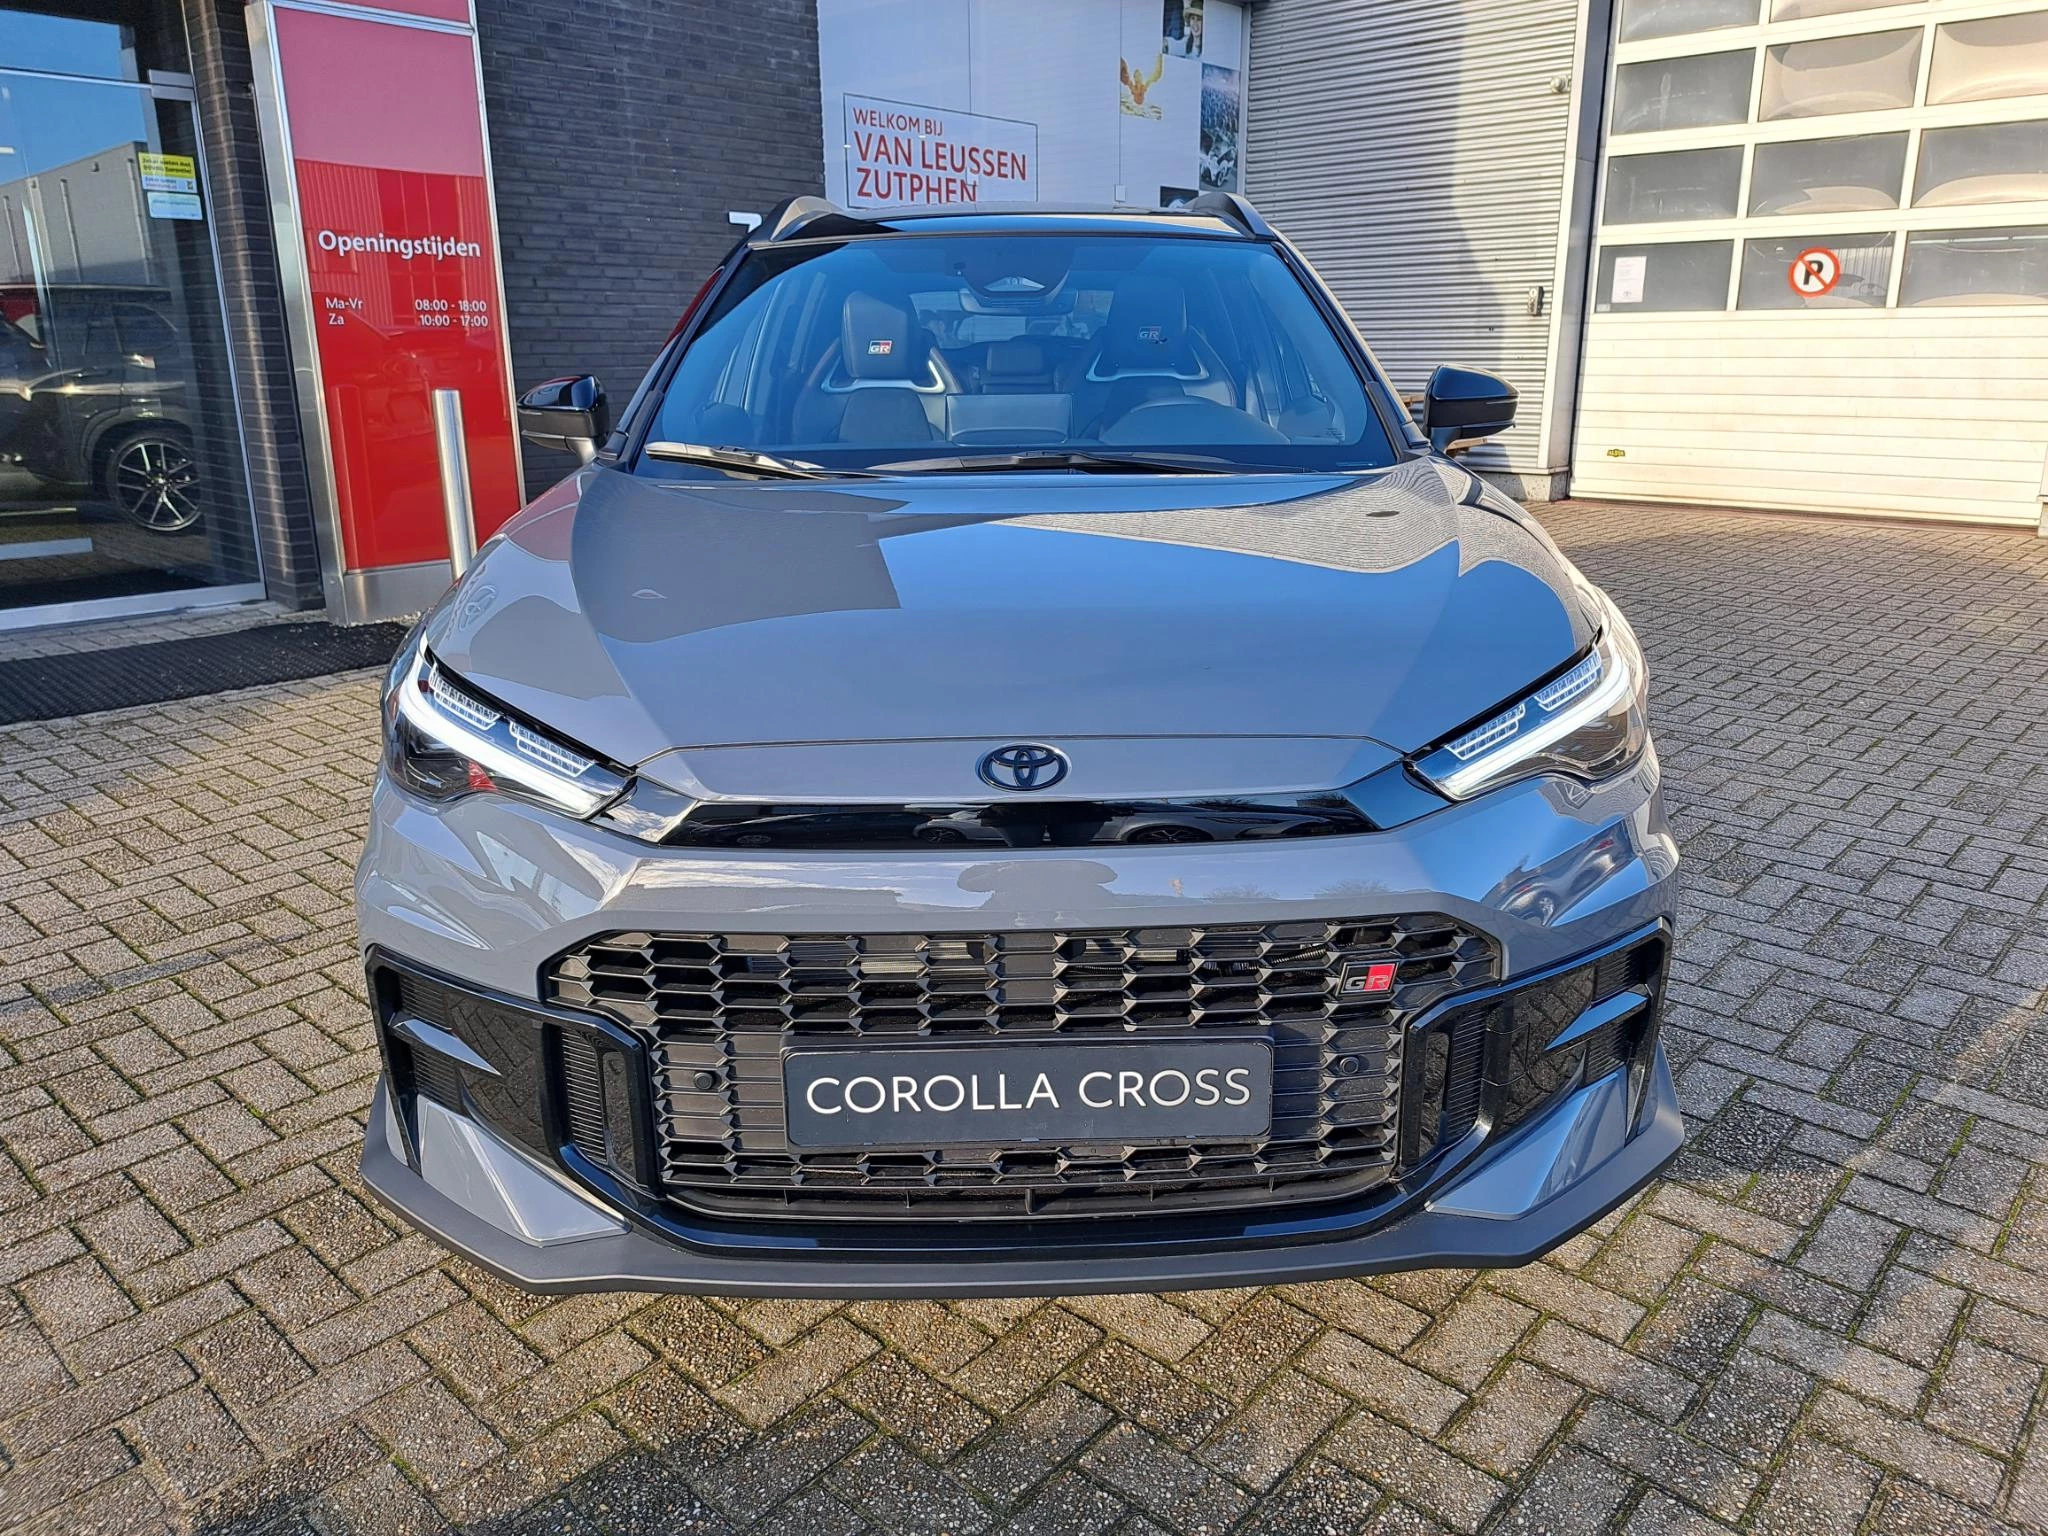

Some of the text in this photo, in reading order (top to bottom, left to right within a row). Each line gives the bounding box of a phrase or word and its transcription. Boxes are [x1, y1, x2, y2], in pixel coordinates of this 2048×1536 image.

[853, 107, 943, 136] WELKOM BIJ
[854, 131, 1026, 181] VAN LEUSSEN
[856, 167, 977, 204] ZUTPHEN
[318, 230, 480, 261] Openingstijden
[325, 297, 363, 310] Ma-Vr
[415, 299, 448, 311] 08:00
[459, 300, 487, 312] 18:00
[328, 313, 345, 325] Za
[420, 315, 450, 326] 10:00
[461, 315, 488, 327] 17:00
[1345, 975, 1389, 990] GR
[806, 1068, 1251, 1115] COROLLA CROSS
